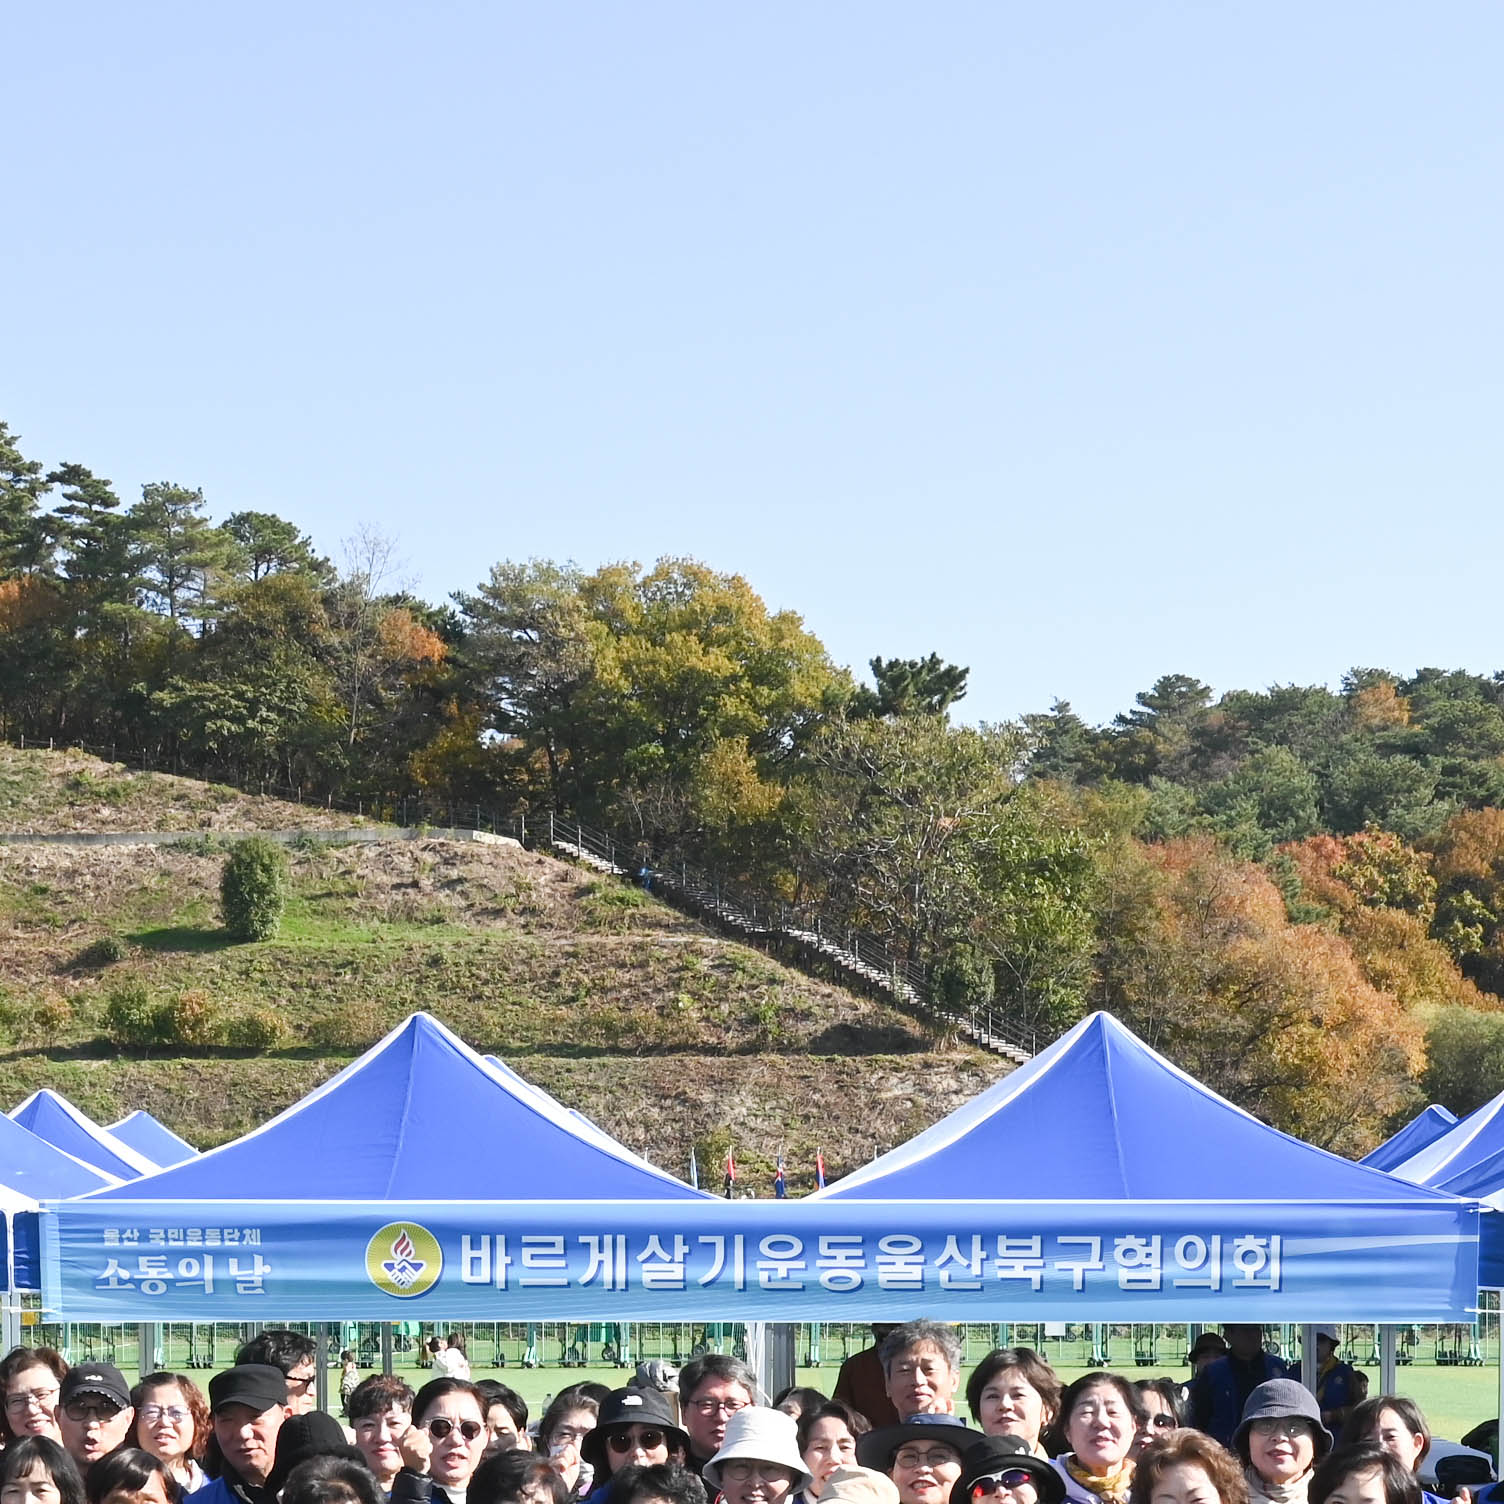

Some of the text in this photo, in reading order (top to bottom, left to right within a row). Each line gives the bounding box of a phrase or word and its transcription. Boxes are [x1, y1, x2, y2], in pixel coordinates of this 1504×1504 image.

[103, 1228, 262, 1246] 울산 국민운동단체
[95, 1253, 272, 1296] 소통의 날
[460, 1233, 1283, 1292] 바르게살기운동울산북구협의회
